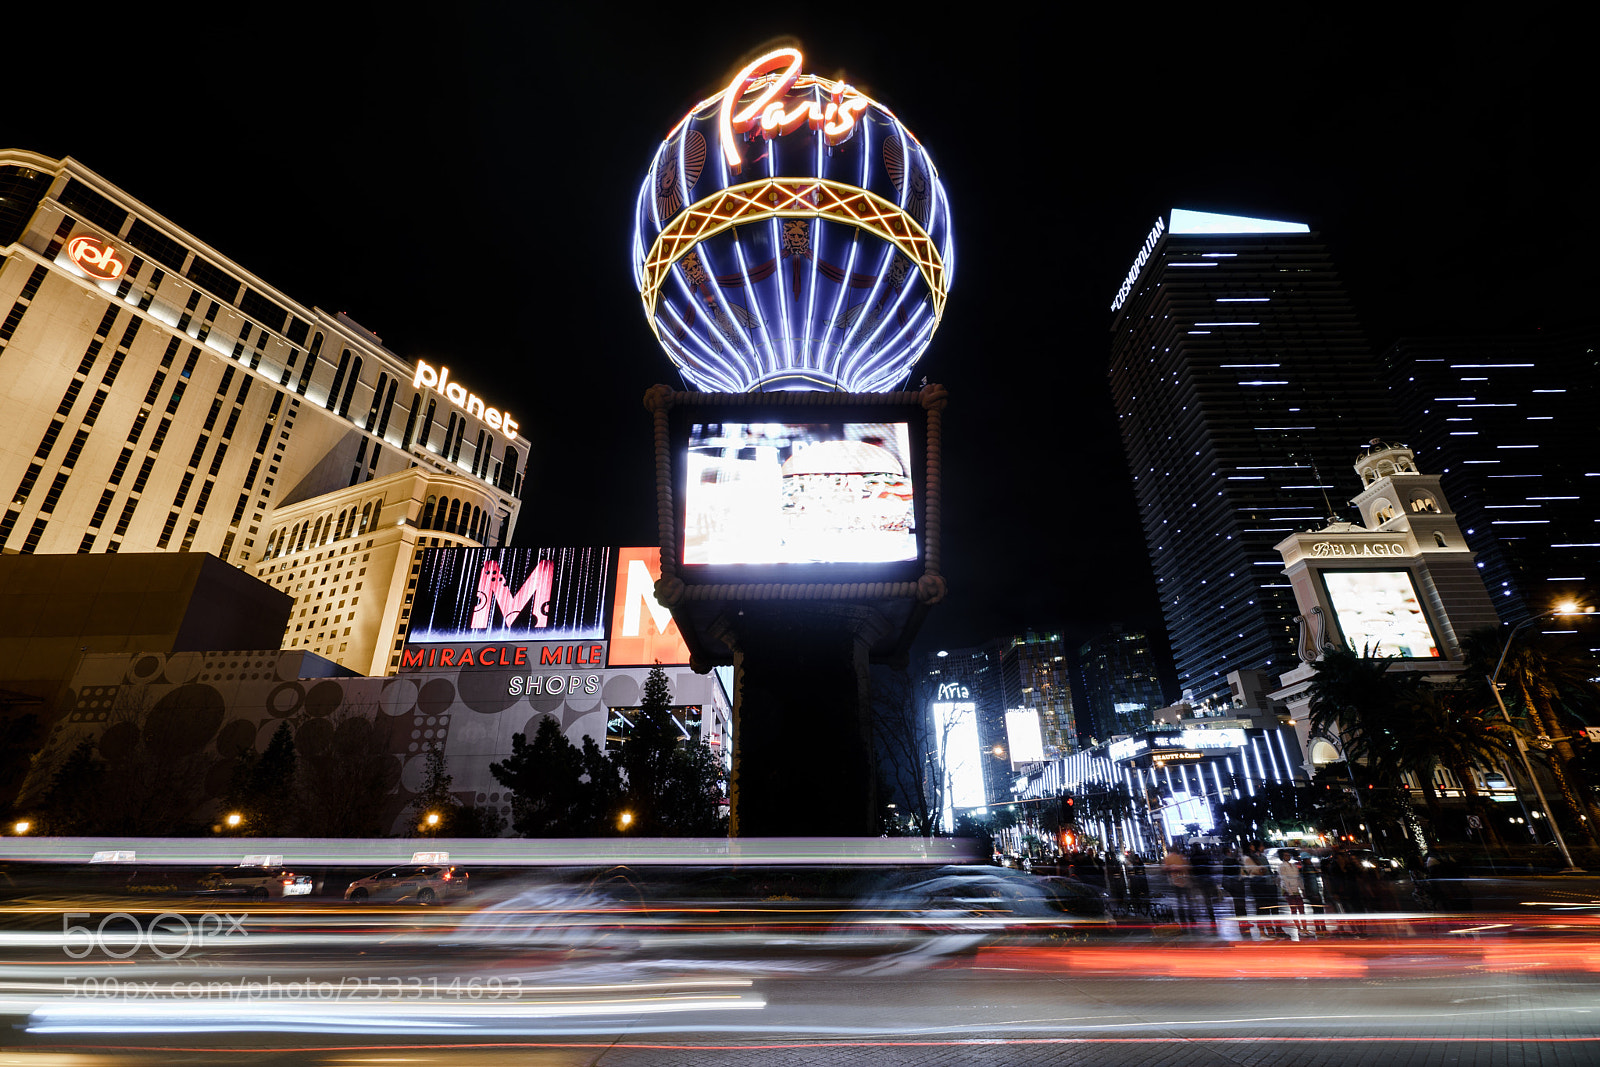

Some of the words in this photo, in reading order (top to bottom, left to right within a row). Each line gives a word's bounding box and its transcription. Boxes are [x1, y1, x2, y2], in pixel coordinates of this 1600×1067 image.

[719, 47, 868, 168] Paris
[73, 238, 124, 278] ph
[1114, 216, 1165, 310] COSMOPOLITAN
[413, 358, 520, 440] planet
[1309, 541, 1405, 557] BELLAGIO
[470, 559, 555, 629] M
[402, 646, 528, 668] MIRACLE
[541, 644, 603, 665] MILE
[508, 674, 601, 696] SHOPS
[937, 682, 970, 701] Aria
